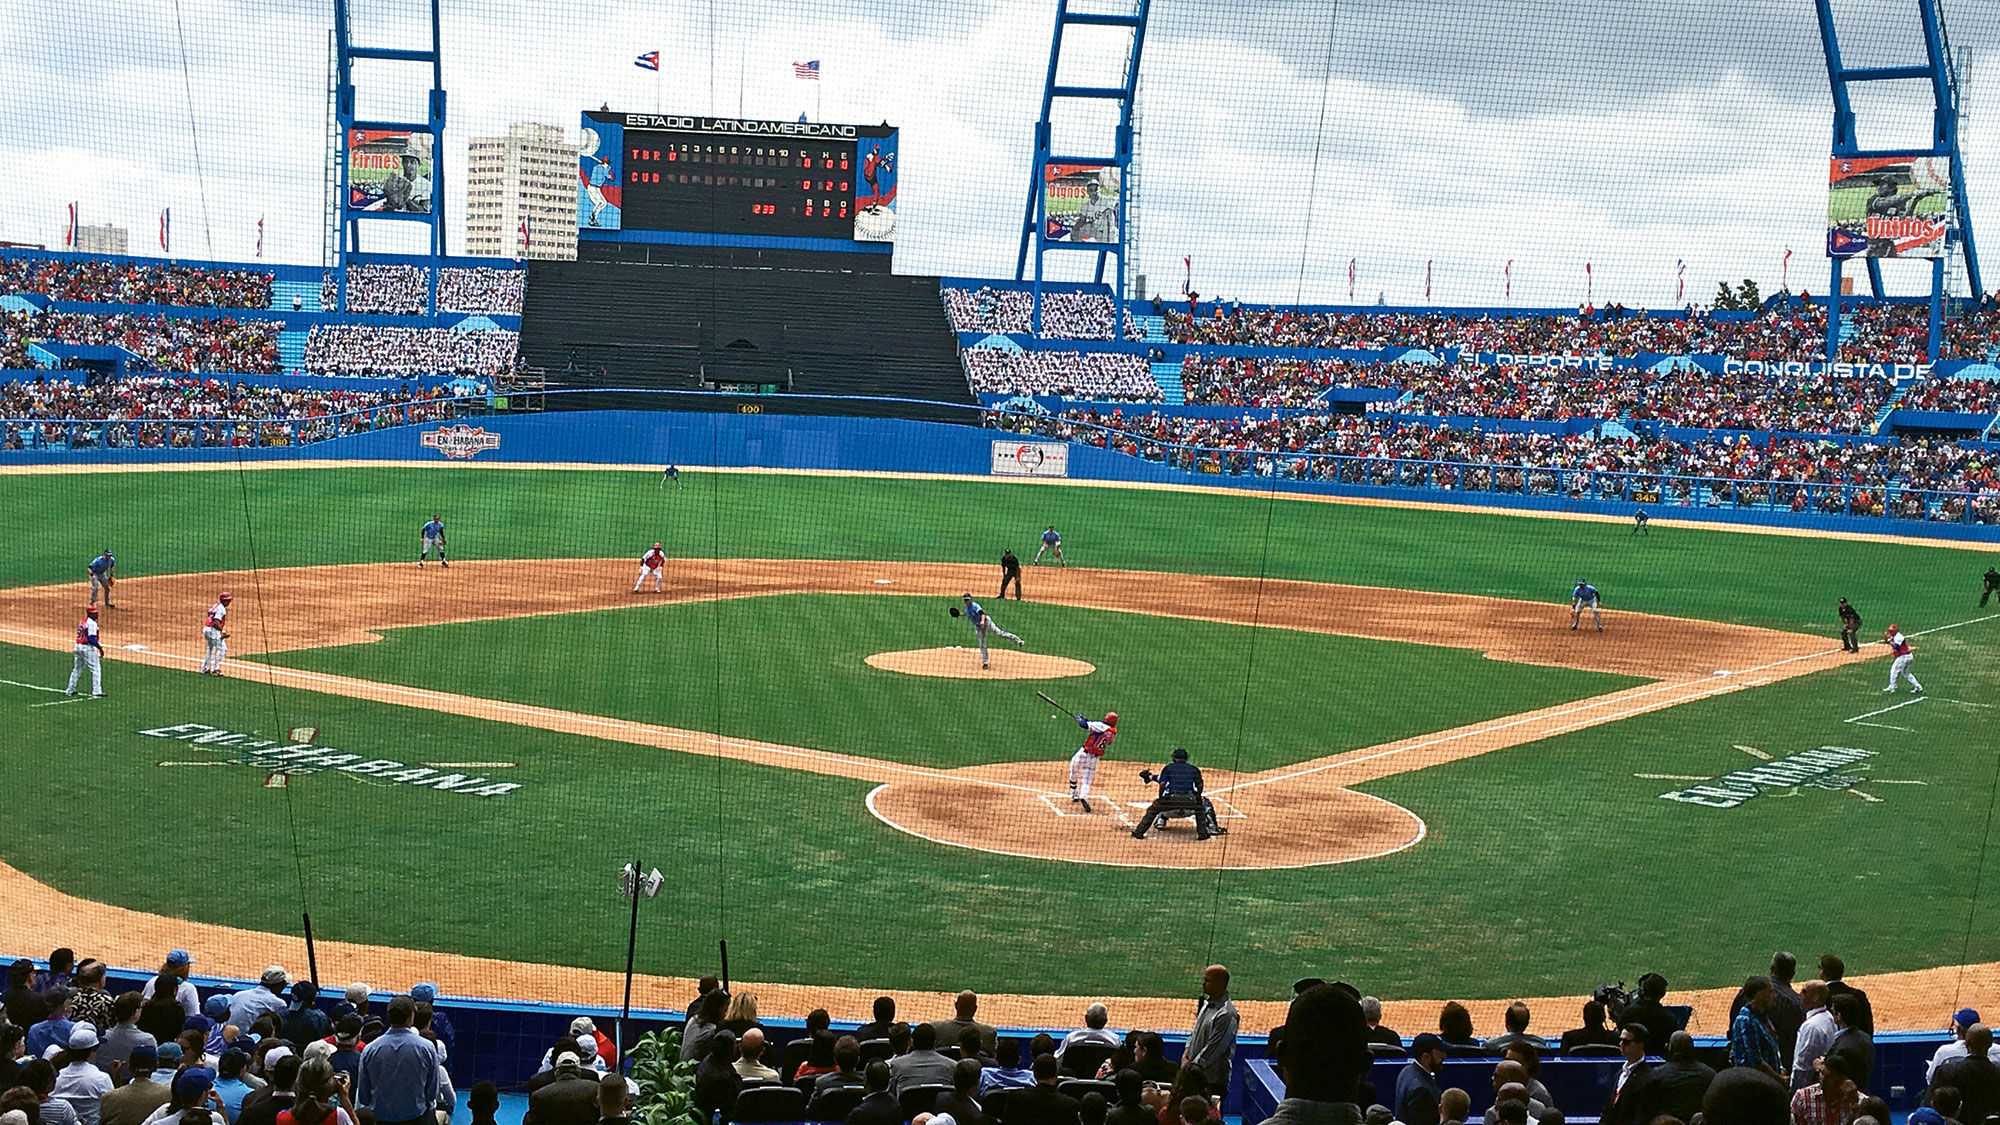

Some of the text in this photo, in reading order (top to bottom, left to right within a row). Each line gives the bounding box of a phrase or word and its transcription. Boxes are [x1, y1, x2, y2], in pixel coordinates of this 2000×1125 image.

[626, 114, 856, 137] ESTADIO LATINOAMERICANO
[631, 148, 661, 161] TBR
[669, 143, 675, 151] 1
[681, 144, 688, 152] 2
[693, 145, 701, 153] 3
[745, 147, 752, 155] 7
[779, 149, 789, 157] 10
[351, 149, 400, 170] Firmes
[1049, 183, 1086, 199] Dignos
[1867, 216, 1934, 239] Unidos
[1496, 353, 1613, 371] DEPORTE
[1723, 360, 1887, 379] CONQUISTA
[741, 405, 760, 413] 400
[137, 722, 249, 744] EN
[248, 743, 523, 797] HABANA
